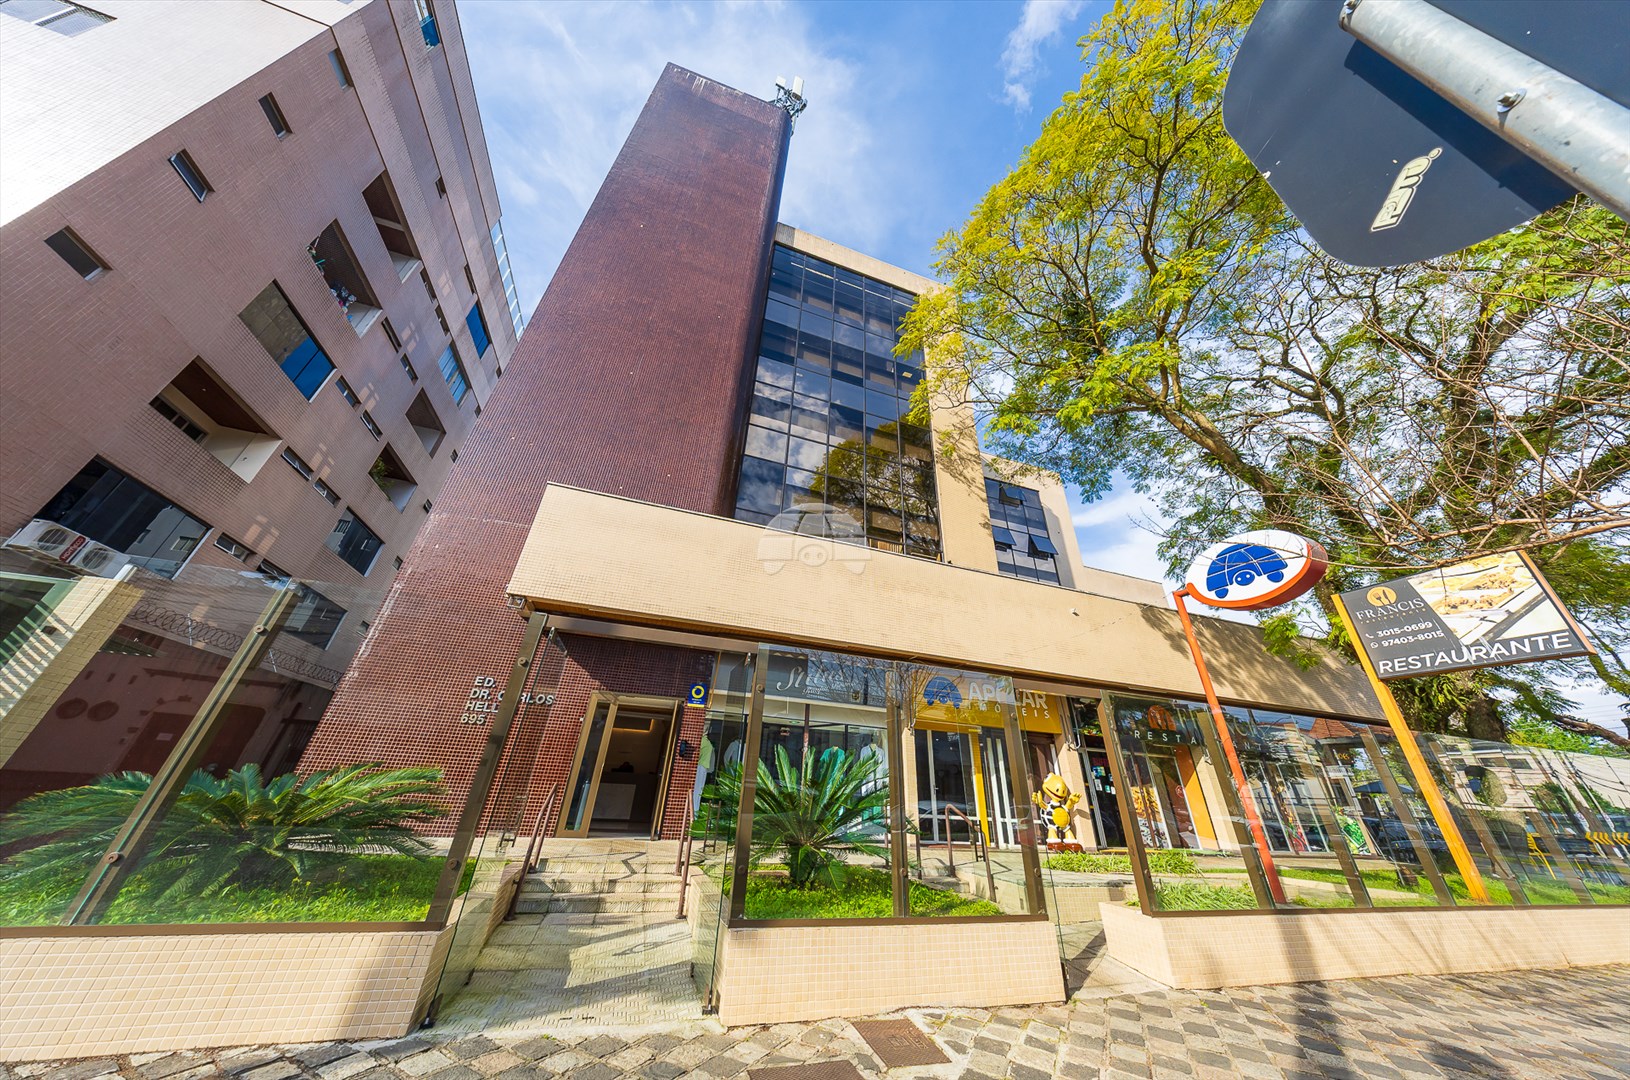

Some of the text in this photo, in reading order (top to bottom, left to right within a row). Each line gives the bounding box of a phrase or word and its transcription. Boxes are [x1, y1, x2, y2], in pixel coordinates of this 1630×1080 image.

[1355, 598, 1424, 620] FRANCIS
[1377, 621, 1433, 637] 3015-0699
[1382, 630, 1445, 647] 97403-8015
[1379, 632, 1572, 674] RESTAURANTE
[474, 676, 496, 688] ED.
[470, 688, 491, 700] DR.
[465, 700, 499, 713] HELL
[461, 713, 486, 724] 695
